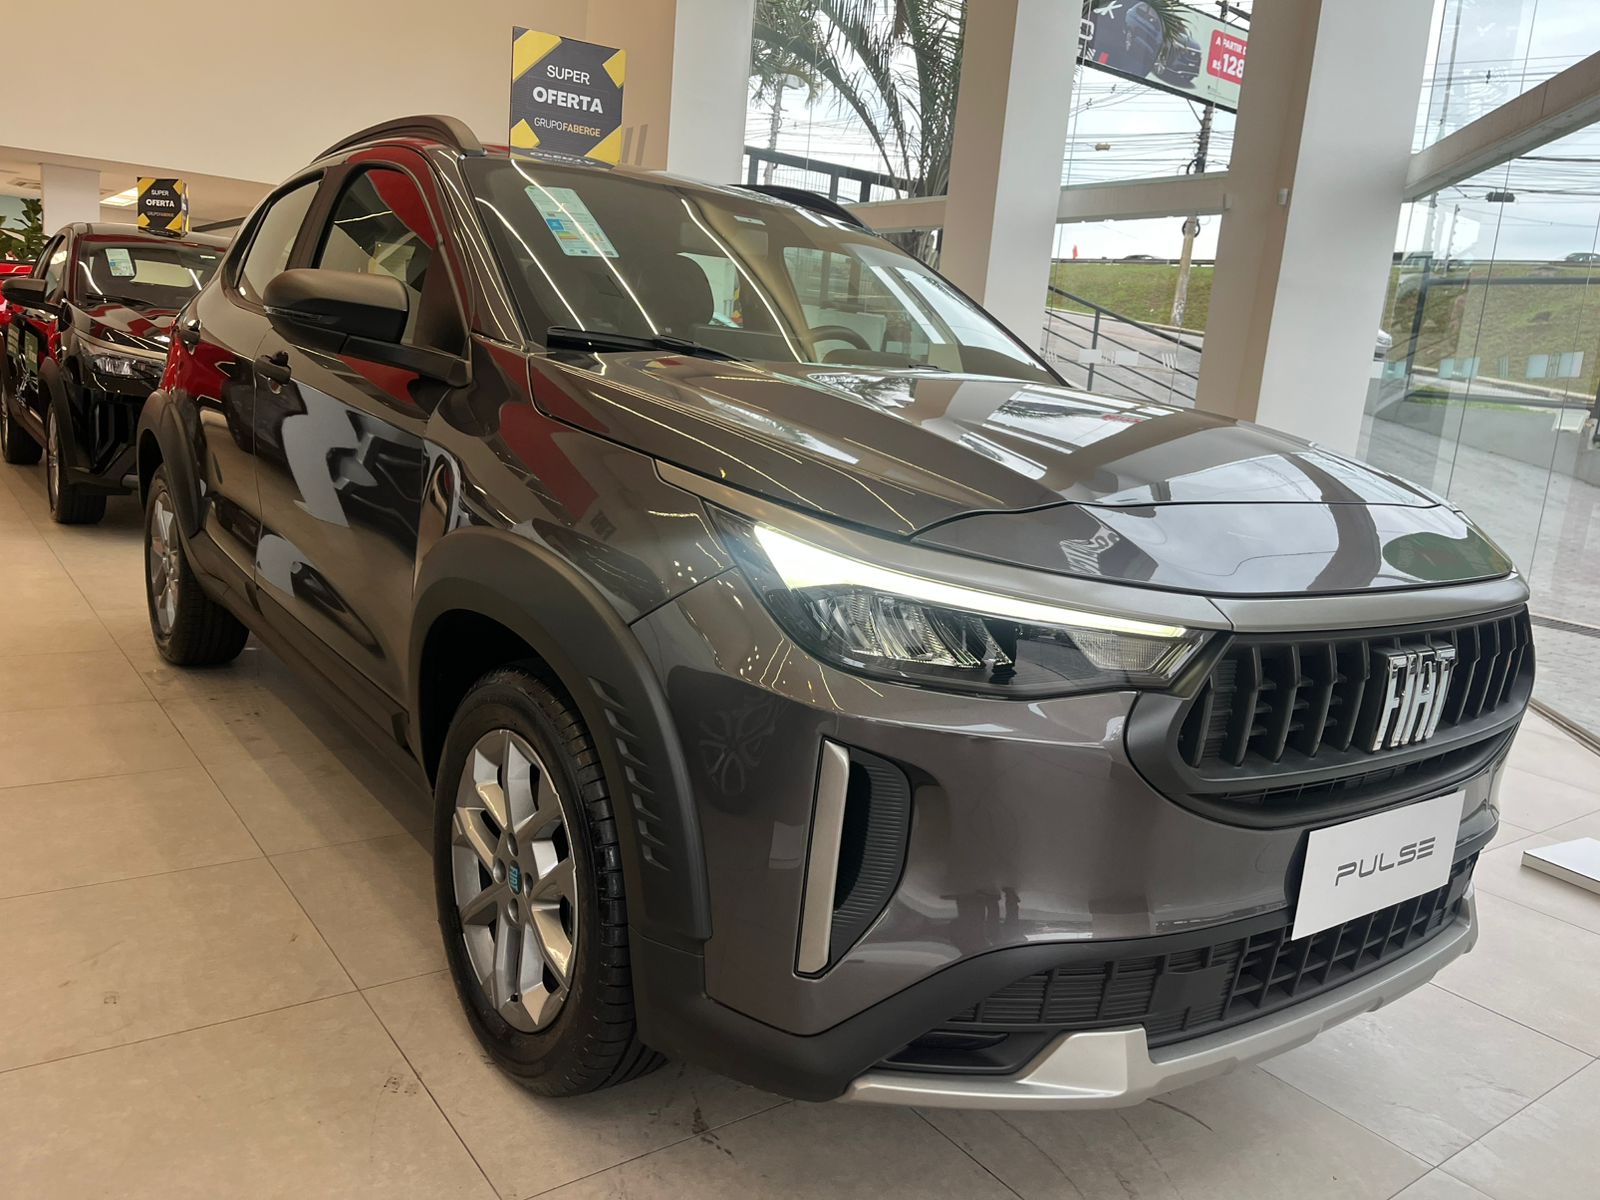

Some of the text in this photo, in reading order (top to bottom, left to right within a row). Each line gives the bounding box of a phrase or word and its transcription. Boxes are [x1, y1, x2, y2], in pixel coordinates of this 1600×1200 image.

[546, 64, 590, 85] SUPER
[1222, 53, 1245, 79] 128
[532, 86, 604, 114] OFERTA
[145, 198, 175, 208] OFERTA
[151, 189, 170, 197] SUPER
[1372, 648, 1456, 752] FIAT
[1334, 836, 1437, 887] PULSE
